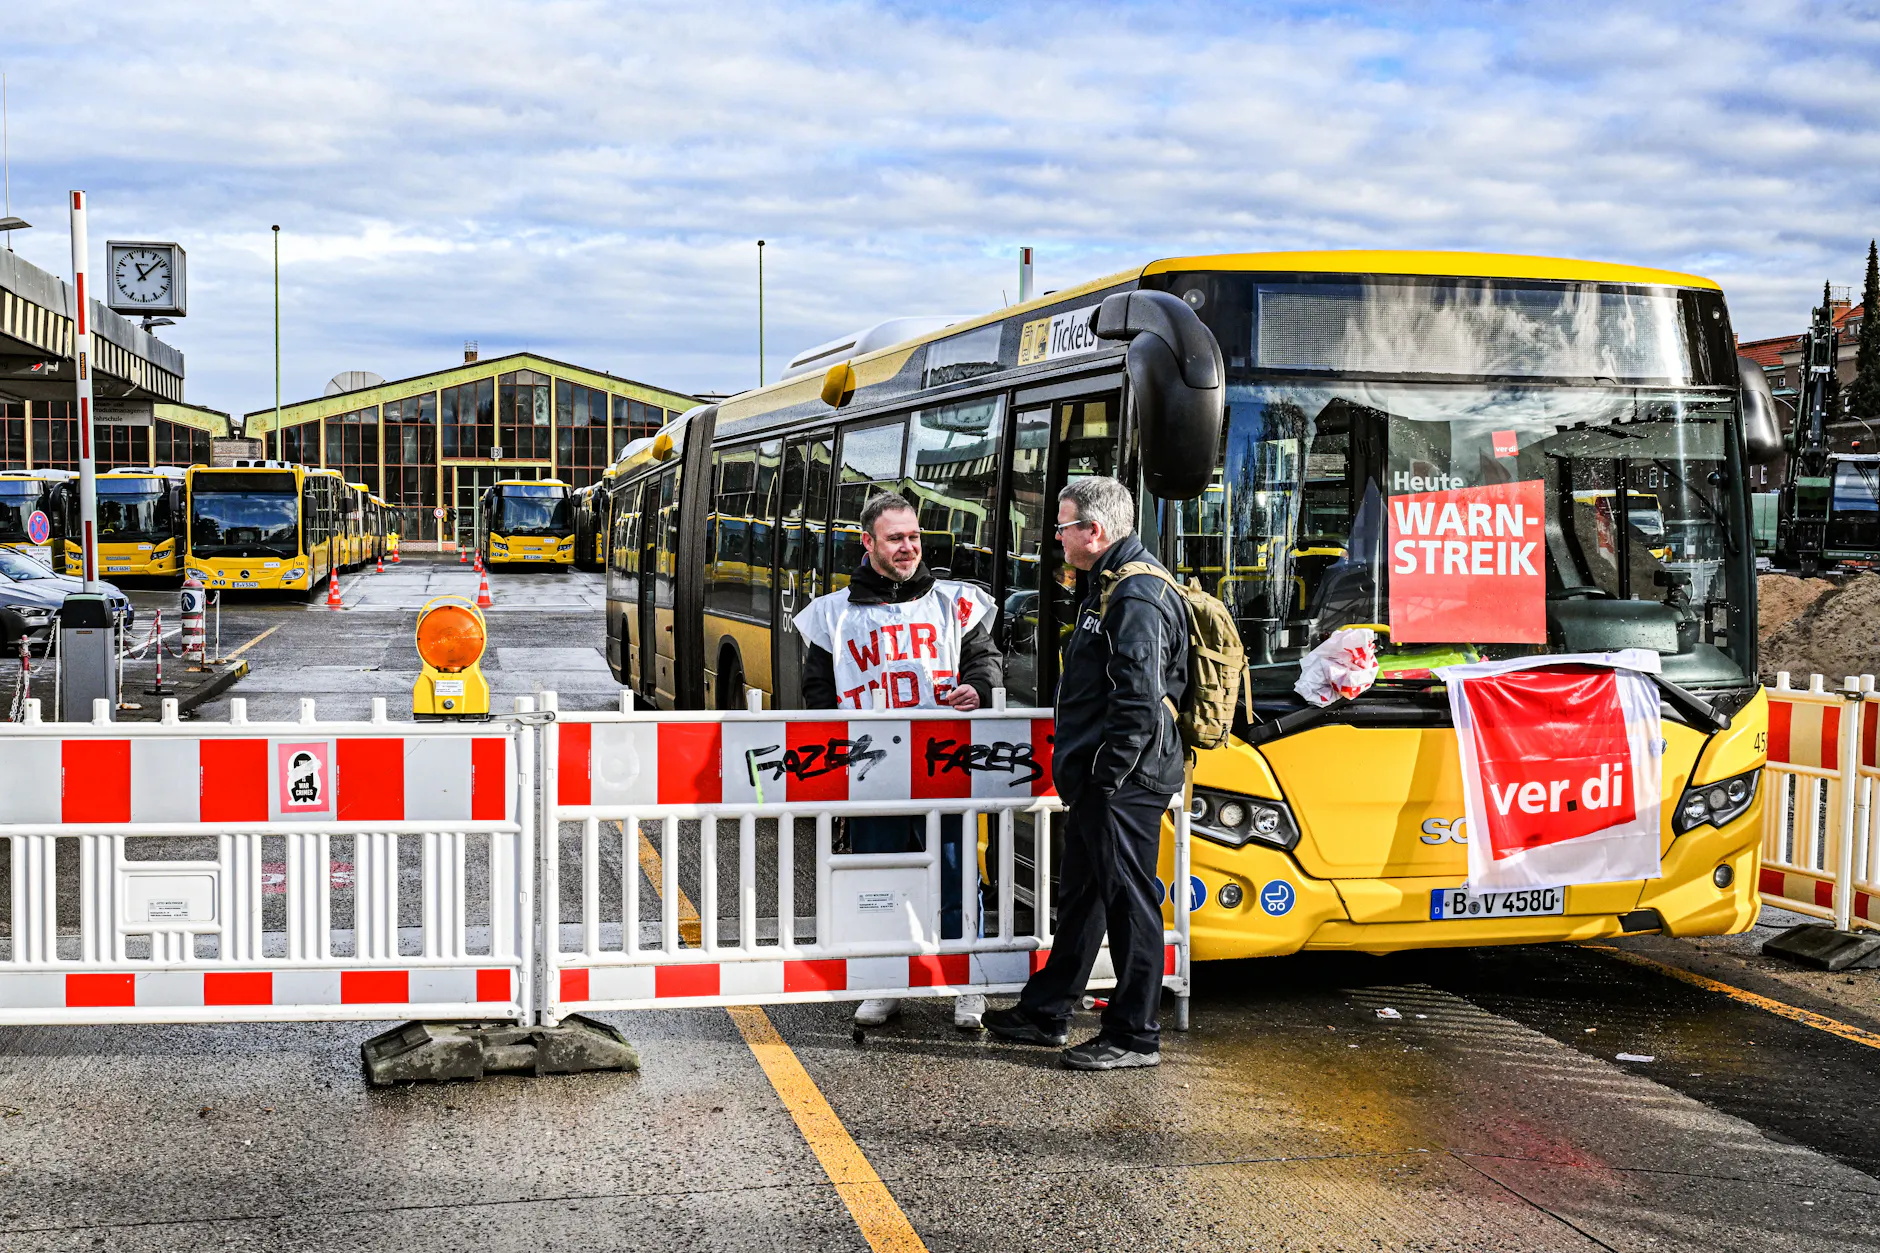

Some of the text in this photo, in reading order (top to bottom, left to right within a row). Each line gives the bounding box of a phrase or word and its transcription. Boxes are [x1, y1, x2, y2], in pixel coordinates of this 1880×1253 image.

[1052, 315, 1096, 354] Tickets
[1394, 471, 1464, 491] Heute
[1394, 501, 1539, 537] WARN-
[1394, 540, 1539, 576] STREIK
[847, 622, 938, 673] WIR
[1490, 763, 1623, 816] ver.di
[1453, 892, 1467, 915] B
[1484, 893, 1497, 913] V
[1502, 888, 1555, 913] 4580
